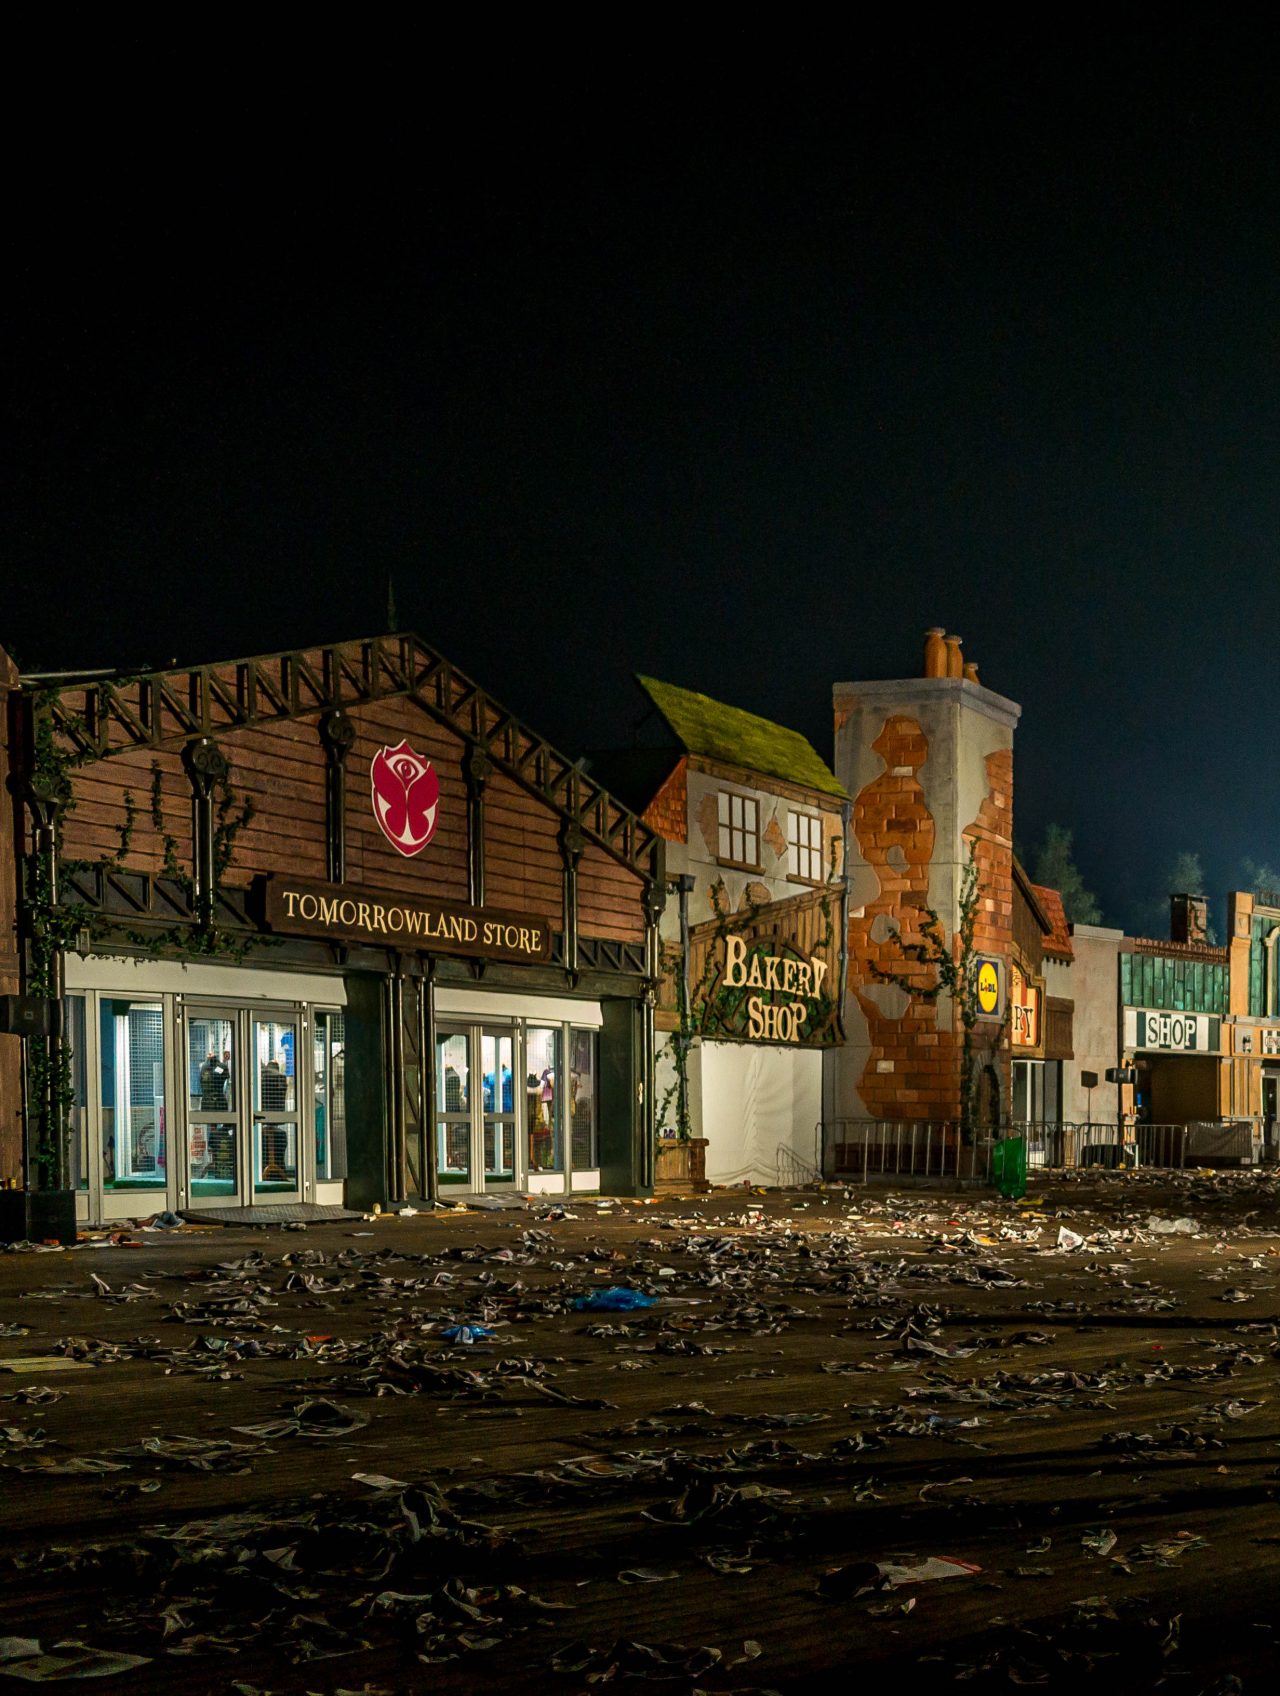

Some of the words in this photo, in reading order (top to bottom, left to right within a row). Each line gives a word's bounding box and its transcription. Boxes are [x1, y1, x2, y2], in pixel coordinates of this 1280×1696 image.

[283, 892, 477, 942] TOMORROWLAND
[483, 922, 541, 953] STORE
[722, 934, 828, 1000] BAKERY
[748, 996, 807, 1041] SHOP
[1147, 1017, 1197, 1047] SHOP
